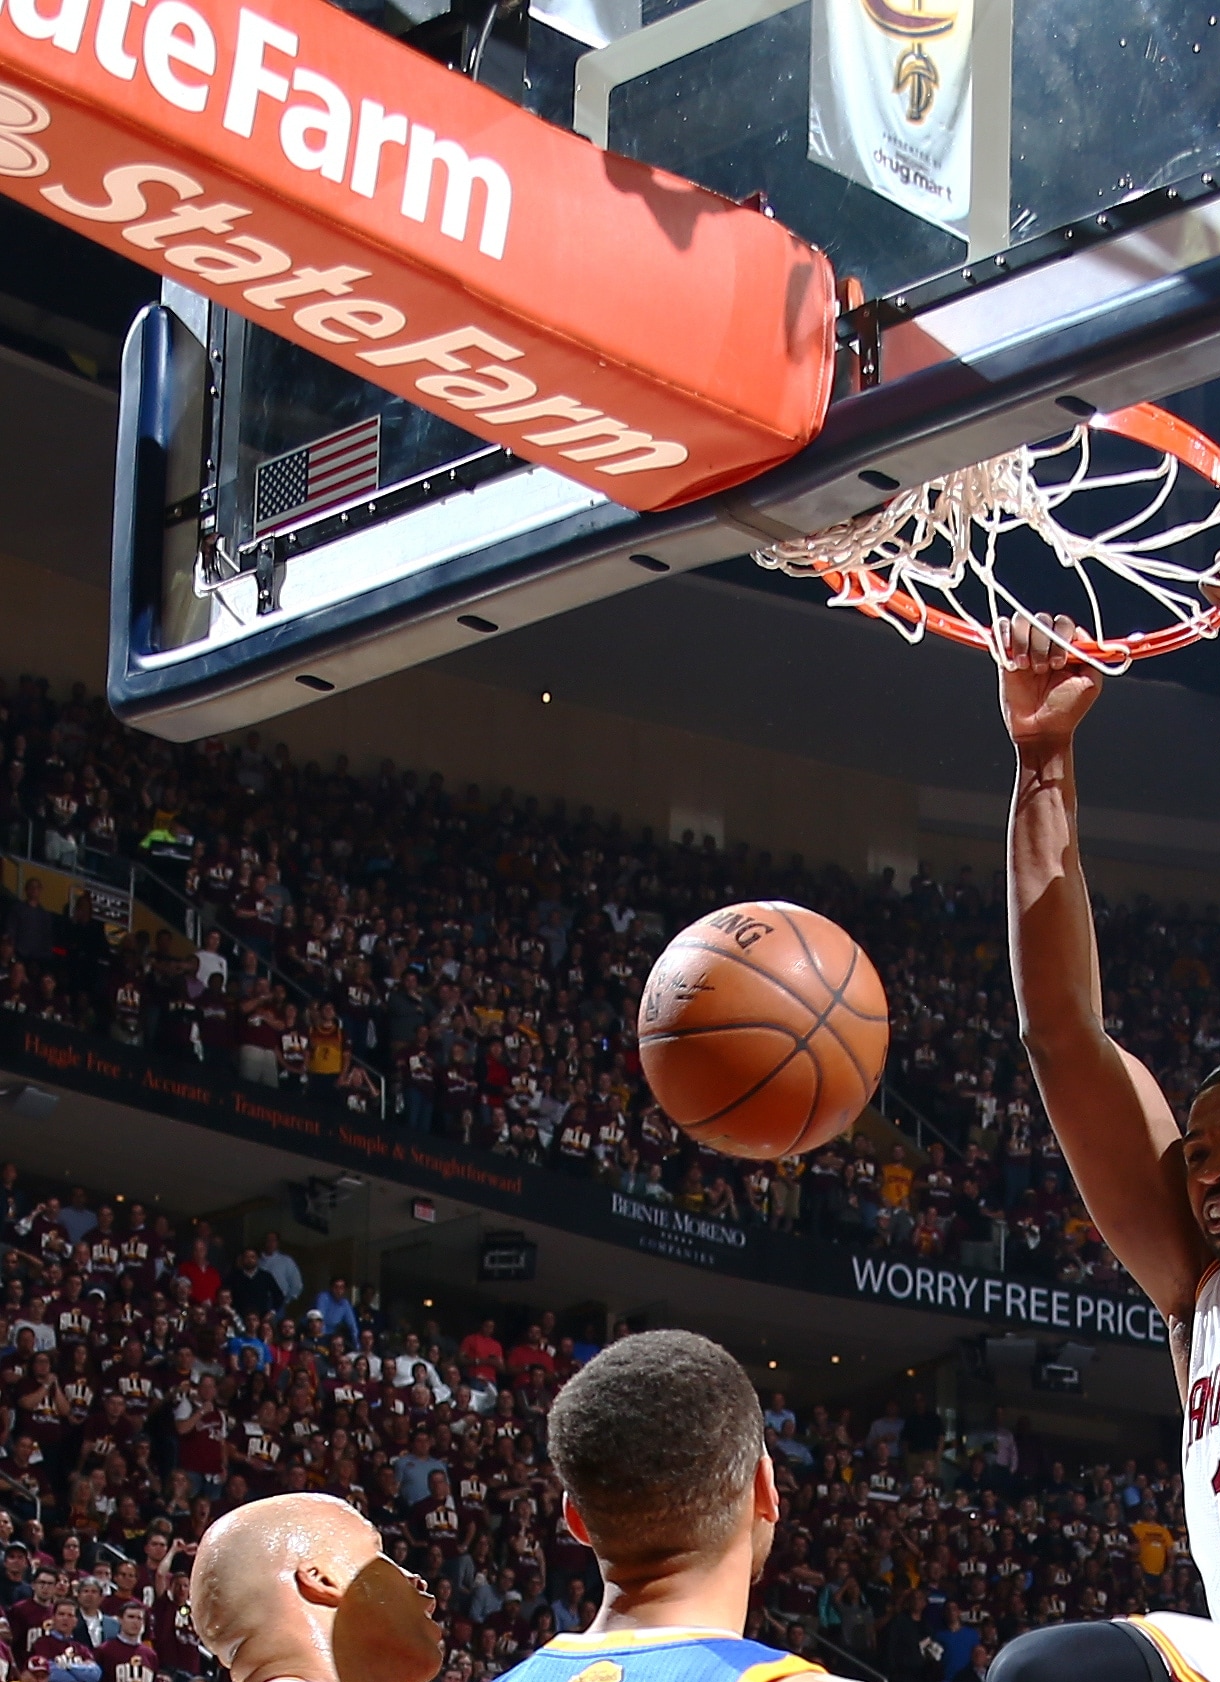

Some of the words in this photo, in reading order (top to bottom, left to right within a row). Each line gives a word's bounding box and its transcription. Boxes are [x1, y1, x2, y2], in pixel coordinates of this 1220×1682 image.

[25, 1031, 82, 1070] Haggle
[87, 1051, 121, 1080] Free
[143, 1068, 211, 1106] Accurate
[232, 1091, 320, 1136] Transparent
[338, 1126, 388, 1156] Simple
[411, 1148, 523, 1194] Straightforward
[612, 1191, 668, 1229] BERNIE
[672, 1210, 747, 1248] MORENO
[852, 1256, 980, 1309] WORRY
[984, 1280, 1071, 1328] FREE
[1076, 1296, 1166, 1343] PRICE
